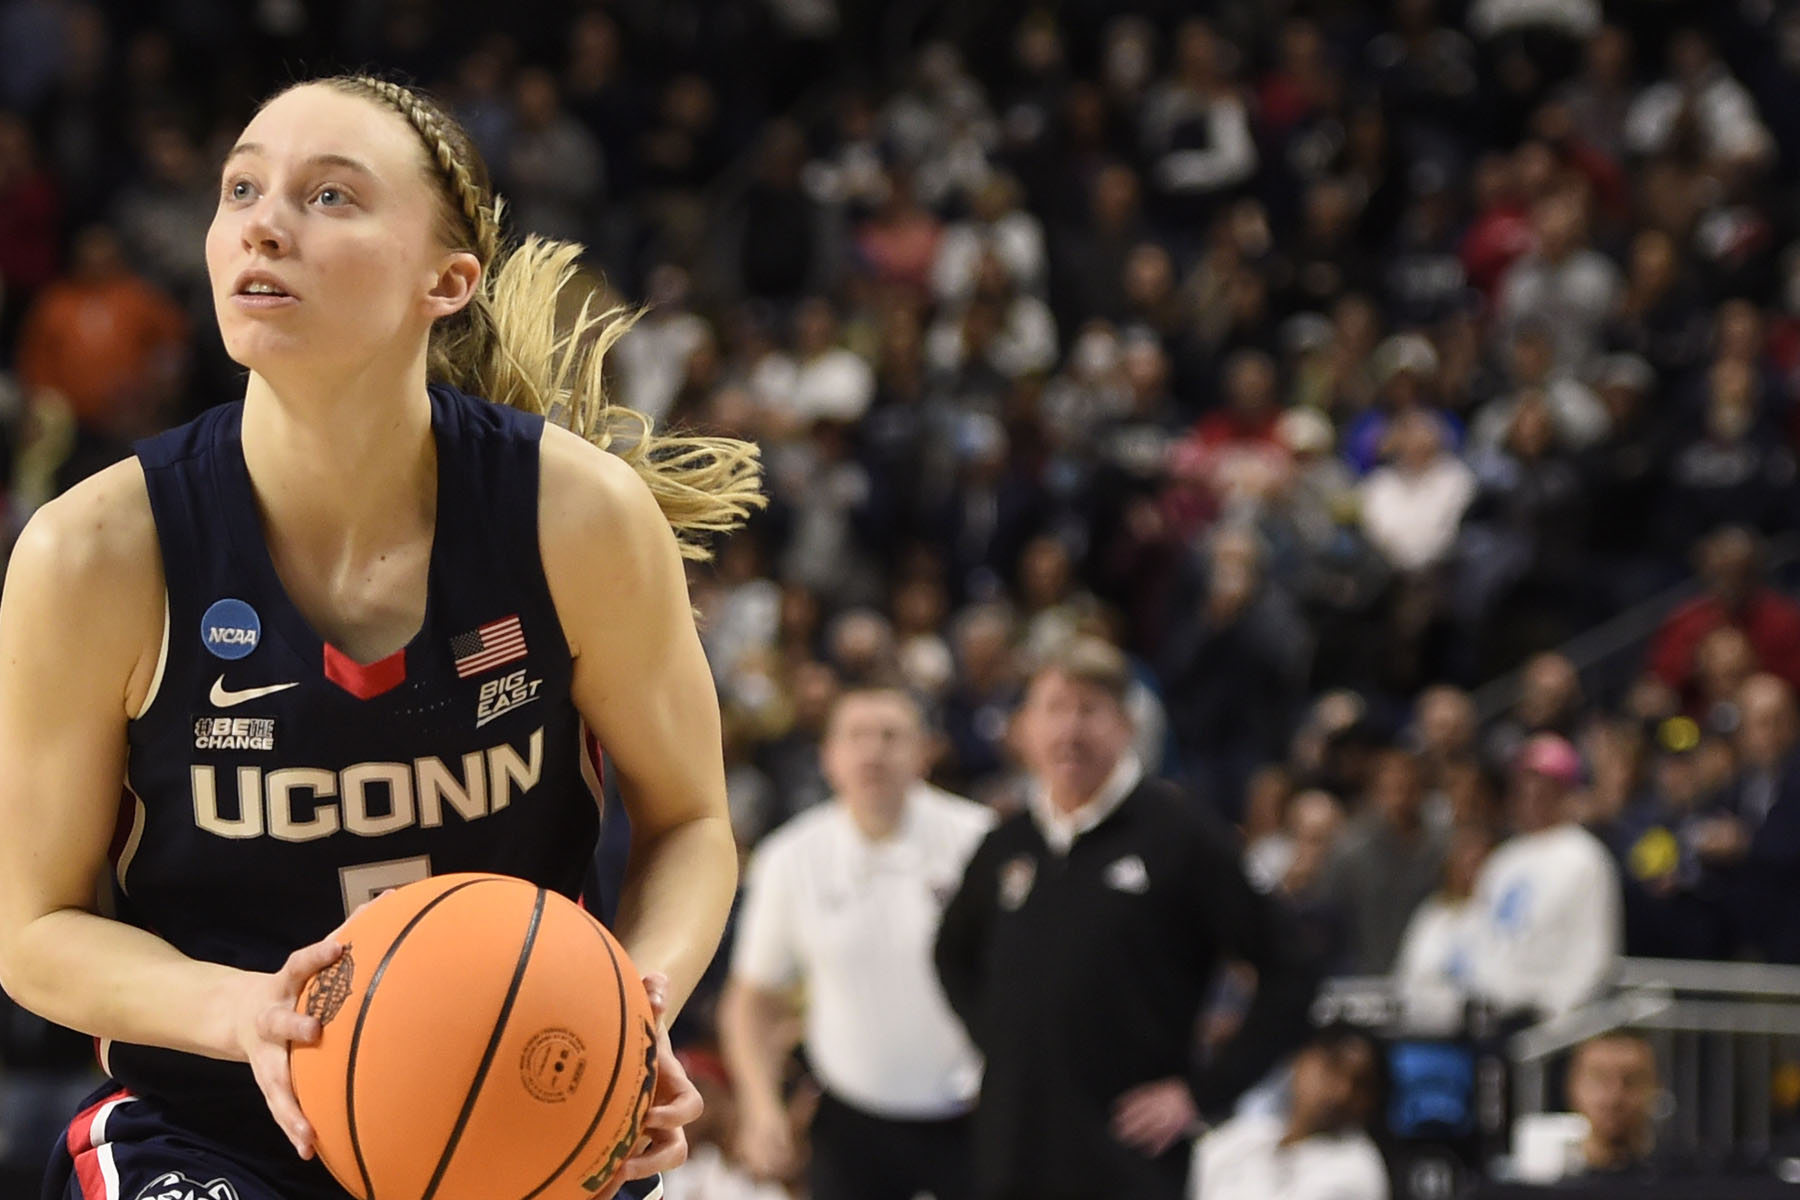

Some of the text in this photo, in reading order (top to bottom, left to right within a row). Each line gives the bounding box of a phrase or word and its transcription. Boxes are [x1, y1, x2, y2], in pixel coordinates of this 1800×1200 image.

[208, 627, 258, 646] NCAA
[476, 679, 544, 717] EAST
[480, 669, 527, 701] BIG
[195, 736, 274, 750] CHANGE
[190, 726, 544, 842] UCONN
